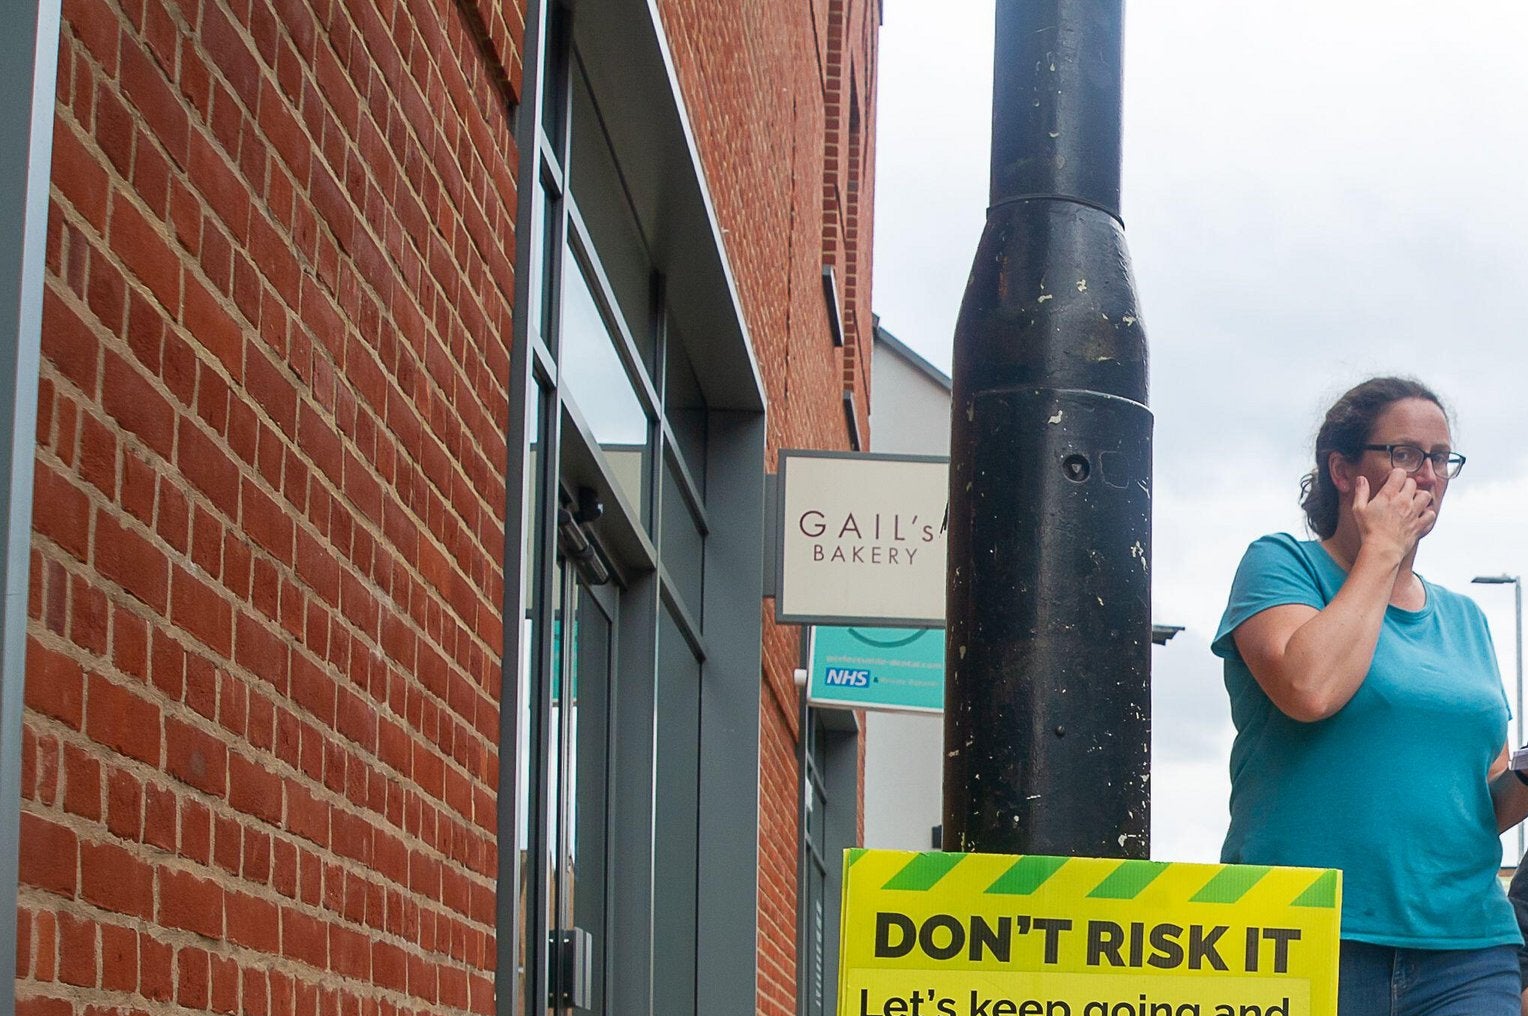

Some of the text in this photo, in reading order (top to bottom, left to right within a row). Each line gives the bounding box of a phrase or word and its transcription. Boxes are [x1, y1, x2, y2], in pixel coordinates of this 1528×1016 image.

[799, 510, 934, 543] GAIL's
[813, 544, 918, 565] BAKERY
[826, 669, 868, 686] NHS
[874, 911, 1302, 974] DON'T RISK IT
